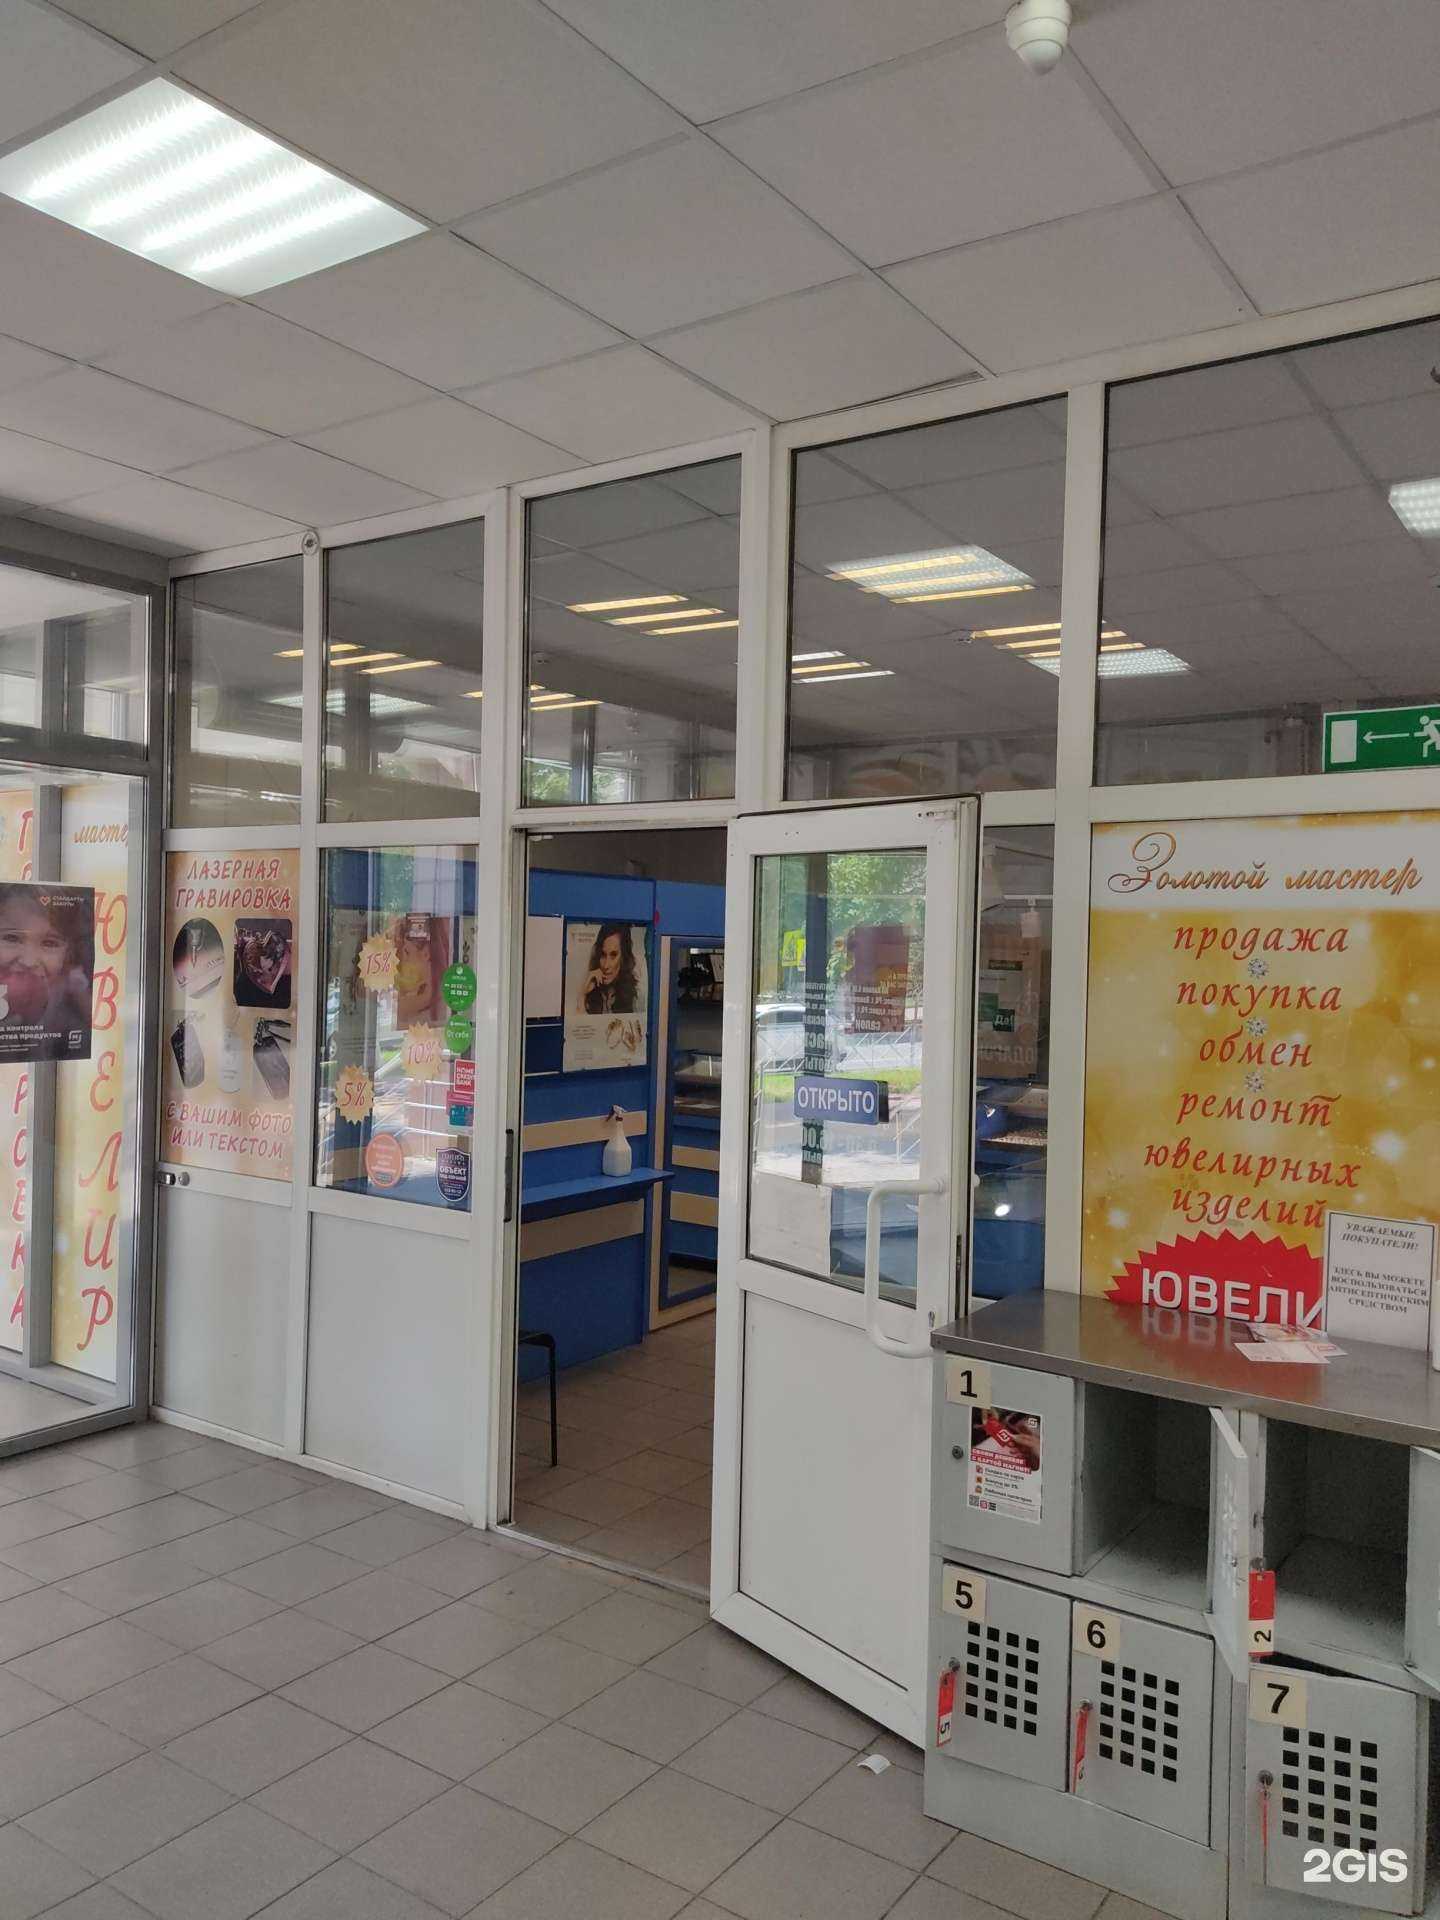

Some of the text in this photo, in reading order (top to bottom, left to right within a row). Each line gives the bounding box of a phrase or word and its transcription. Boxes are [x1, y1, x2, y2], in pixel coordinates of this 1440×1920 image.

[187, 858, 281, 880] ЛАЗЕРНАЯ
[1107, 832, 1424, 895] Золотой мастер
[175, 887, 292, 910] ГРАВИРОВКА
[1174, 926, 1349, 960] продажа
[366, 951, 391, 975] 15%
[1177, 982, 1342, 1017] покупка
[408, 1041, 432, 1064] 10%
[1200, 1025, 1313, 1067] обмен
[341, 1081, 367, 1106] 5%
[798, 1086, 875, 1114] ОТКРЫТО
[167, 1102, 292, 1134] С ВАШИМ ФОТО
[1175, 1091, 1342, 1127] ремонт
[171, 1127, 283, 1159] ИЛИ ТЕКСТОМ
[1143, 1136, 1362, 1188] ювелирных
[1172, 1188, 1328, 1228] изделий
[1345, 1223, 1416, 1239] УВАЖАЕМЫЕ
[1331, 1275, 1427, 1296] ВОСПОЛЬЗОВАТЬСЯ
[1365, 1271, 1380, 1279] ВЫ
[1382, 1273, 1425, 1286] МОЖЕТЕ
[960, 1370, 978, 1399] 1
[955, 1580, 973, 1609] 5
[1087, 1620, 1106, 1649] 6
[1254, 1629, 1272, 1643] 2
[1267, 1683, 1290, 1714] 7
